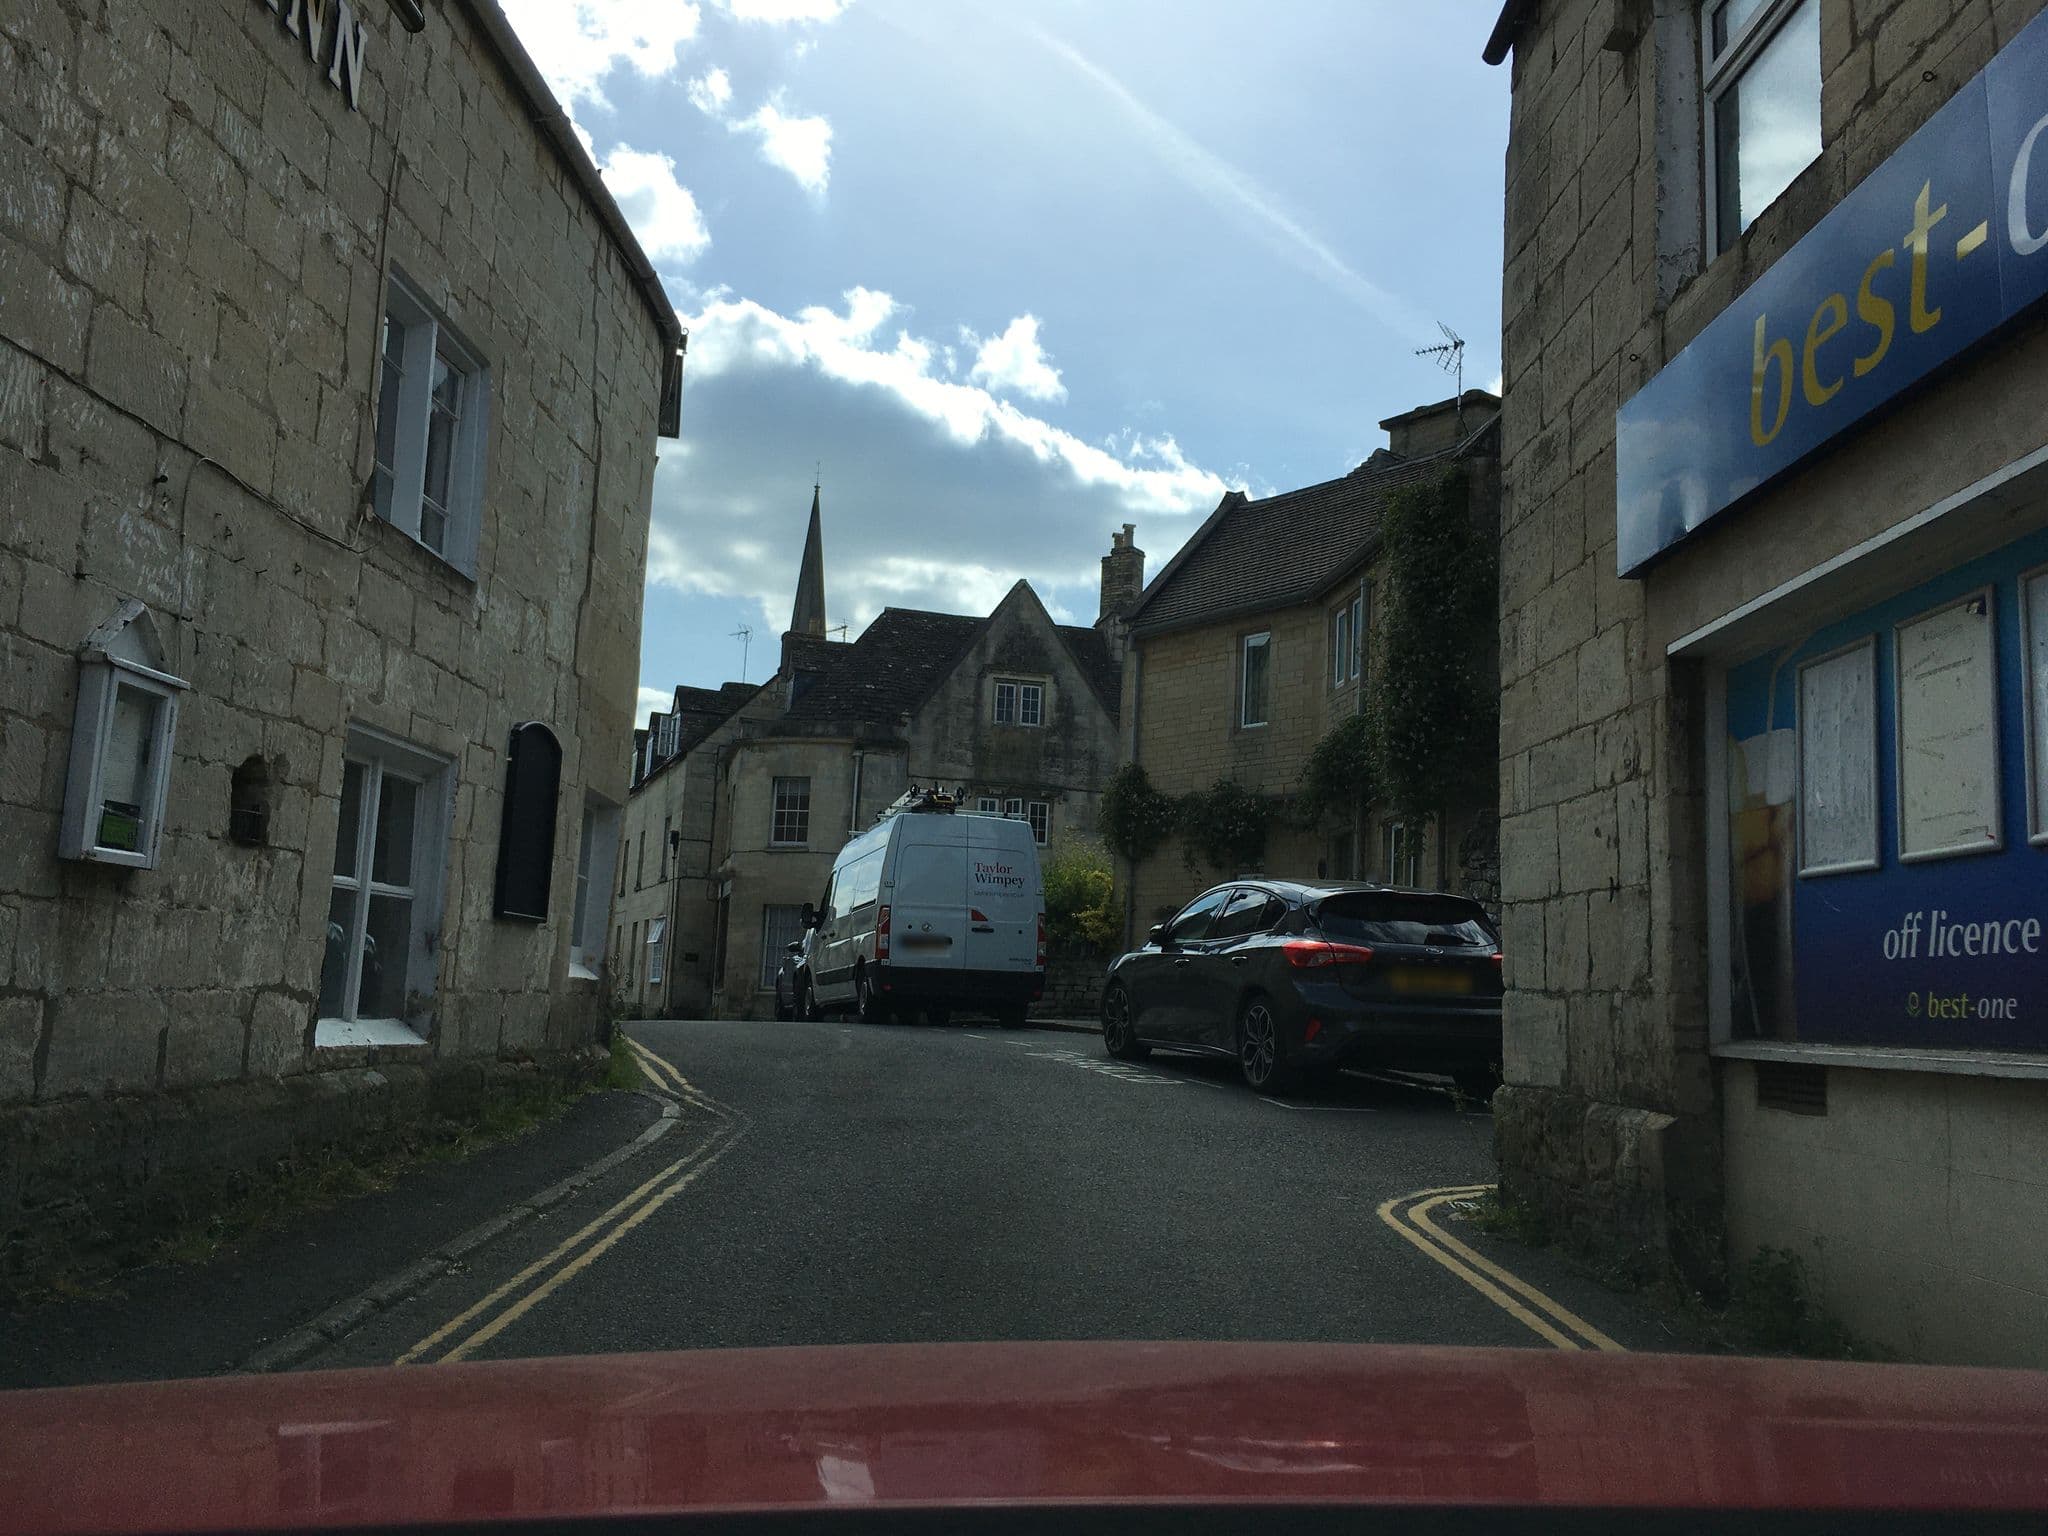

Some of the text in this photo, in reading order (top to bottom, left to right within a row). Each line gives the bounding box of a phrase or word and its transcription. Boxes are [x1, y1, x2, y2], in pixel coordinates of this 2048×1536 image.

[974, 861, 1013, 875] Taylor
[974, 872, 1025, 889] Wimpey
[1883, 910, 2041, 960] off licence
[1928, 991, 2018, 1019] best-one
